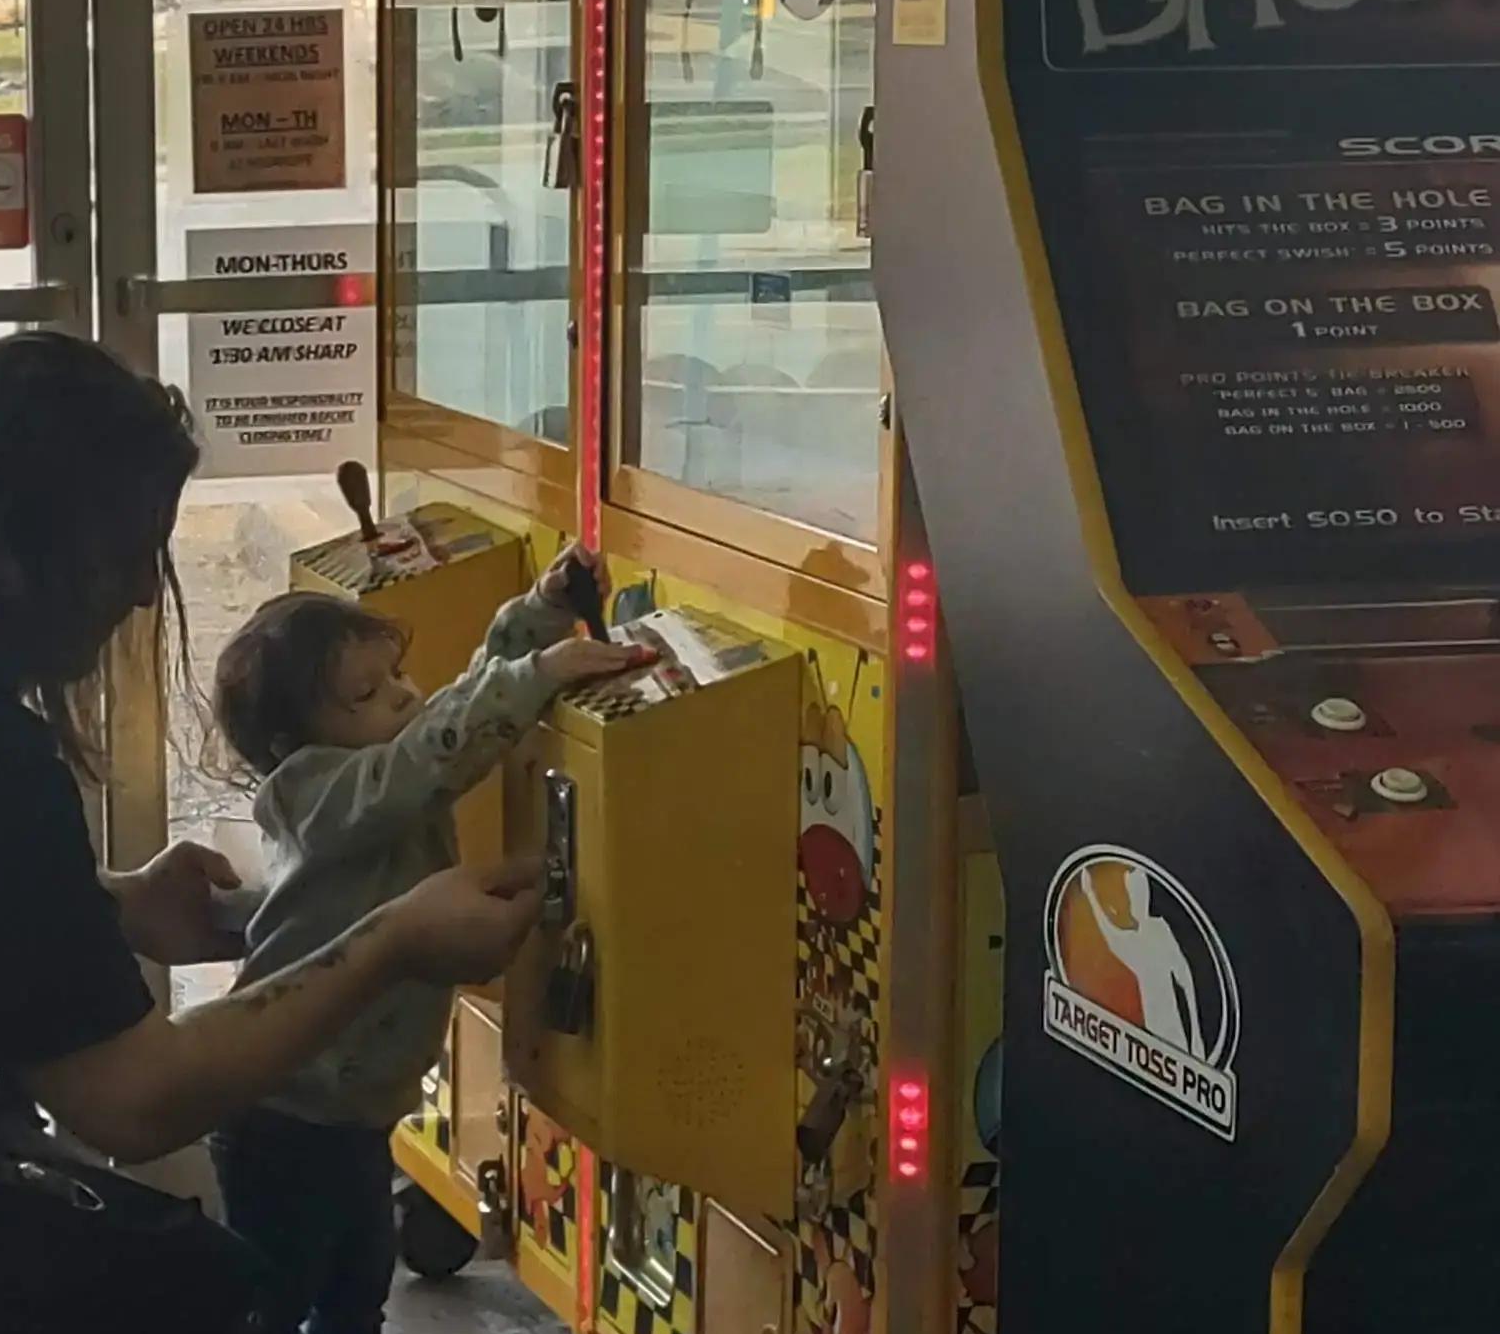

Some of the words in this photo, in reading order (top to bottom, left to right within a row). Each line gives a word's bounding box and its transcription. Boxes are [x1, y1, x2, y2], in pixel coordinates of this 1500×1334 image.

[203, 18, 257, 39] OPEN
[213, 43, 320, 68] WEEKENDS
[221, 112, 271, 131] MON
[292, 109, 317, 130] TH
[1145, 196, 1226, 215] BAG
[1243, 194, 1282, 213] IN
[1299, 192, 1375, 212] THE
[1393, 189, 1492, 209] HOLE
[1308, 221, 1350, 234] BOX
[1377, 215, 1399, 233] 3
[1406, 218, 1486, 232] POINTS
[1384, 241, 1406, 258] 5
[1415, 242, 1493, 255] POINTS
[216, 252, 349, 274] MON-THURS
[1177, 299, 1249, 318] BAG
[1264, 298, 1313, 316] ON
[1329, 296, 1396, 314] THE
[1412, 293, 1482, 311] BOX
[222, 319, 255, 336] WE
[257, 317, 317, 334] CLOSE
[320, 316, 347, 332] AT
[1291, 321, 1306, 338] 1
[1315, 325, 1379, 337] POINT
[210, 347, 252, 364] 1:30
[256, 346, 292, 362] AM
[295, 343, 358, 361] SHARP
[1236, 370, 1317, 384] POINTS
[1218, 408, 1255, 419] BAG
[1262, 407, 1280, 417] IN
[1326, 403, 1371, 415] HOLE
[1225, 425, 1263, 436] BAG
[1269, 424, 1294, 435] ON
[1303, 423, 1334, 434] THE
[1341, 421, 1376, 432] BOX
[1213, 513, 1293, 532] Insert
[1414, 507, 1444, 524] to
[1051, 992, 1121, 1054] TARGET
[1124, 1032, 1177, 1087] TOSS
[1183, 1065, 1226, 1114] PRO
